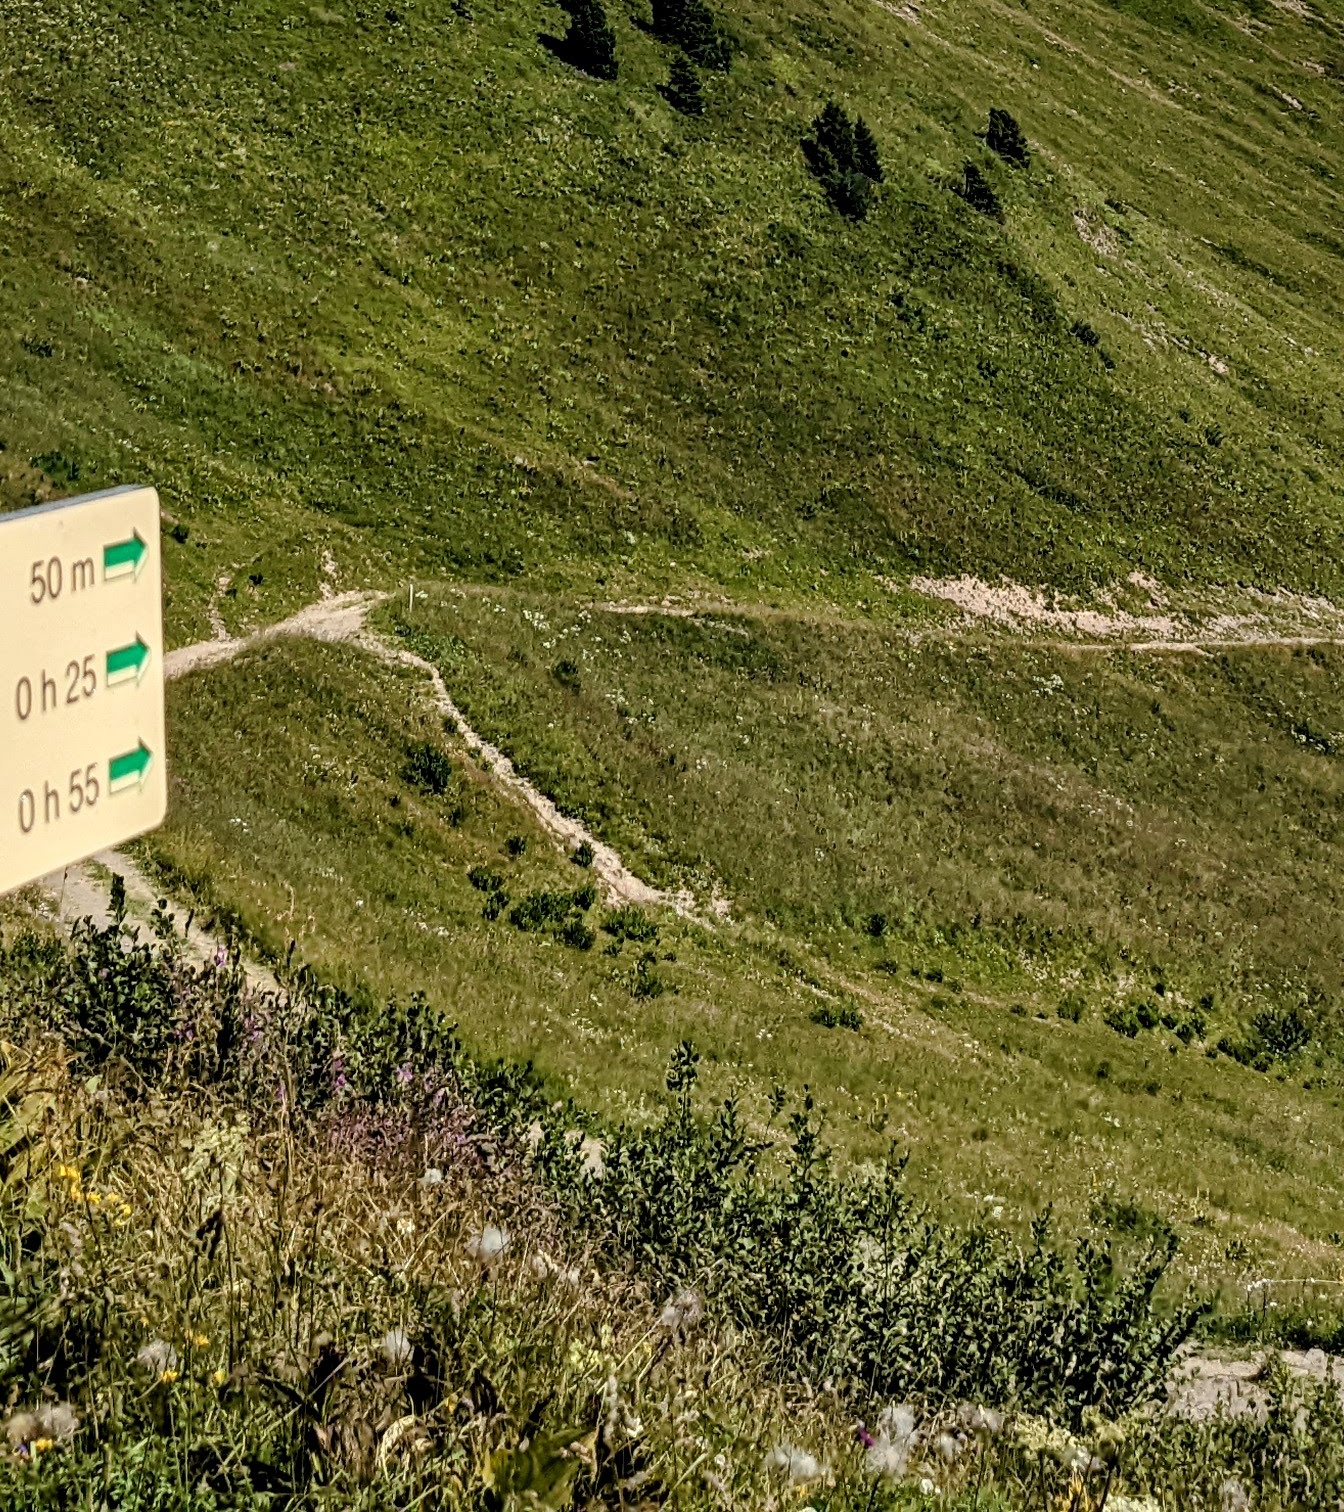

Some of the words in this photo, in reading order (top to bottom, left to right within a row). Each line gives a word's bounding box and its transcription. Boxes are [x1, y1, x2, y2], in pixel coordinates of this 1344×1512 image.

[30, 555, 63, 605] 50
[72, 557, 95, 593] m
[16, 675, 32, 721] 0
[42, 668, 57, 713] h
[66, 654, 96, 705] 25
[19, 787, 35, 833] 0
[45, 779, 60, 824] h
[69, 762, 100, 814] 55
